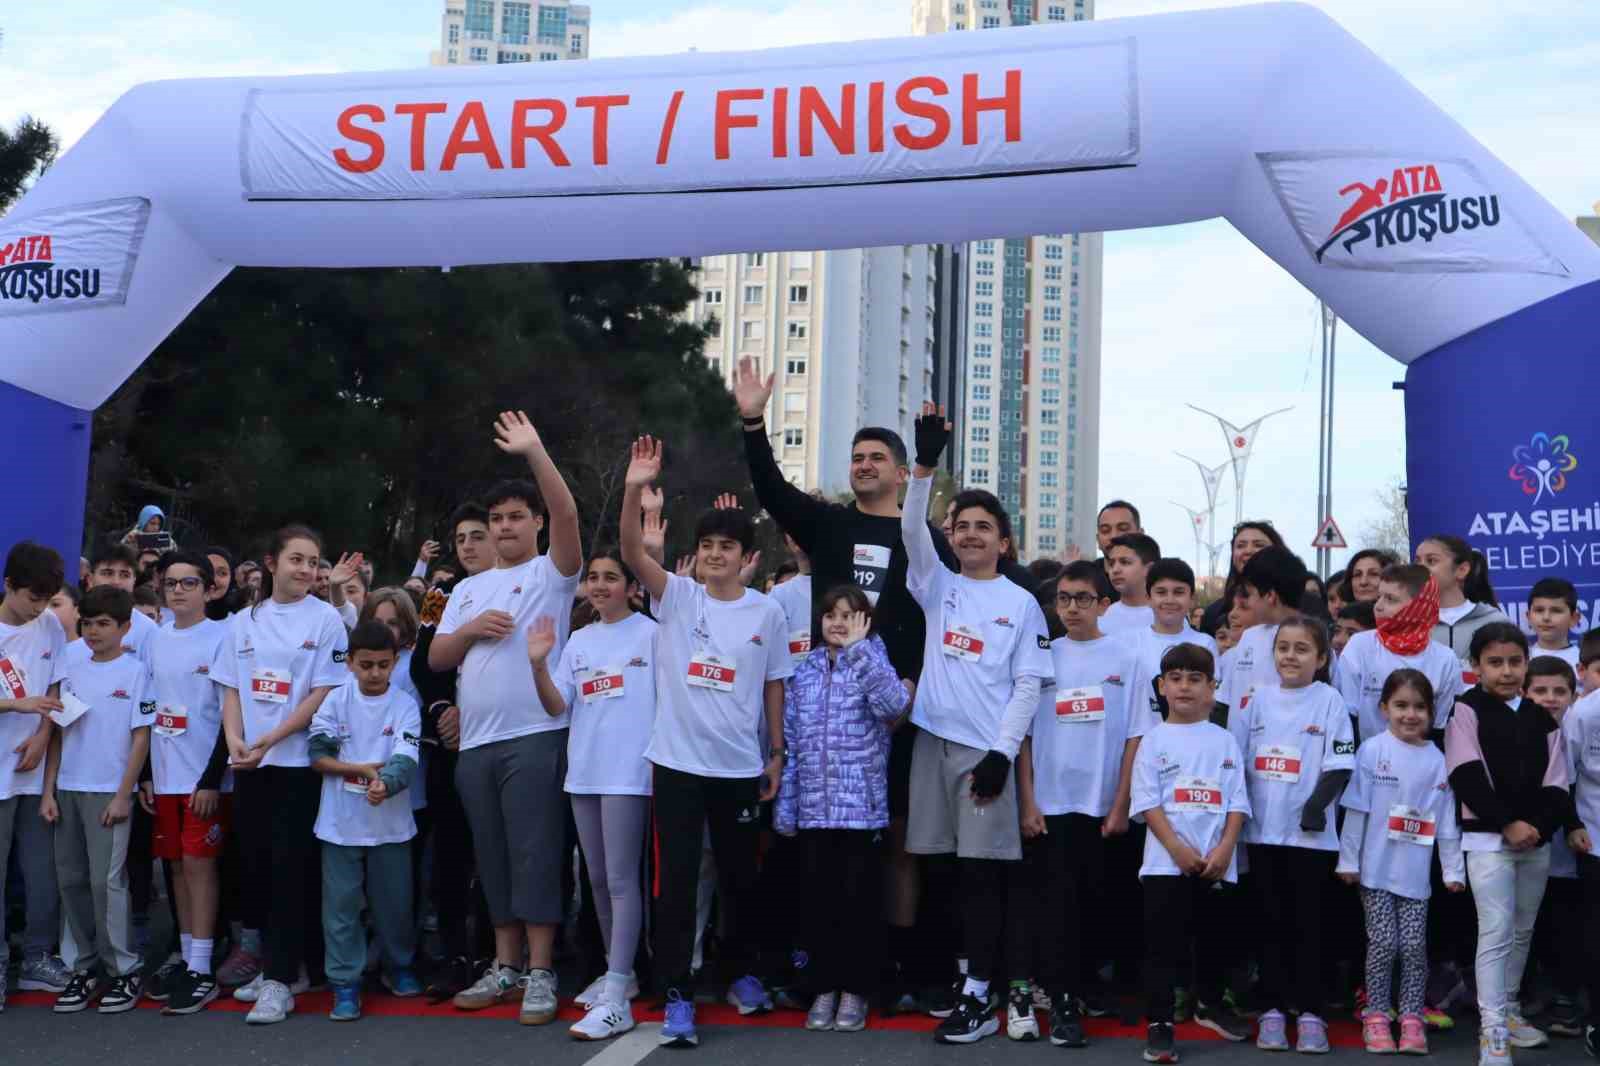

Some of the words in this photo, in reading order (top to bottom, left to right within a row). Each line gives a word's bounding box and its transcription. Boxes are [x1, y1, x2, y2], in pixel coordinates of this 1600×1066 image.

[332, 94, 629, 172] START
[655, 91, 684, 164] /
[713, 69, 1022, 160] FINISH
[1390, 164, 1442, 202] ATA
[1375, 194, 1500, 248] KOŞUSU
[11, 235, 52, 263] ATA
[1472, 539, 1600, 570] ELEDİYE
[951, 634, 971, 649] 149
[702, 666, 721, 679] 176
[259, 681, 277, 693] 134
[1072, 700, 1088, 712] 63
[1265, 758, 1286, 771] 146
[1187, 790, 1211, 802] 190
